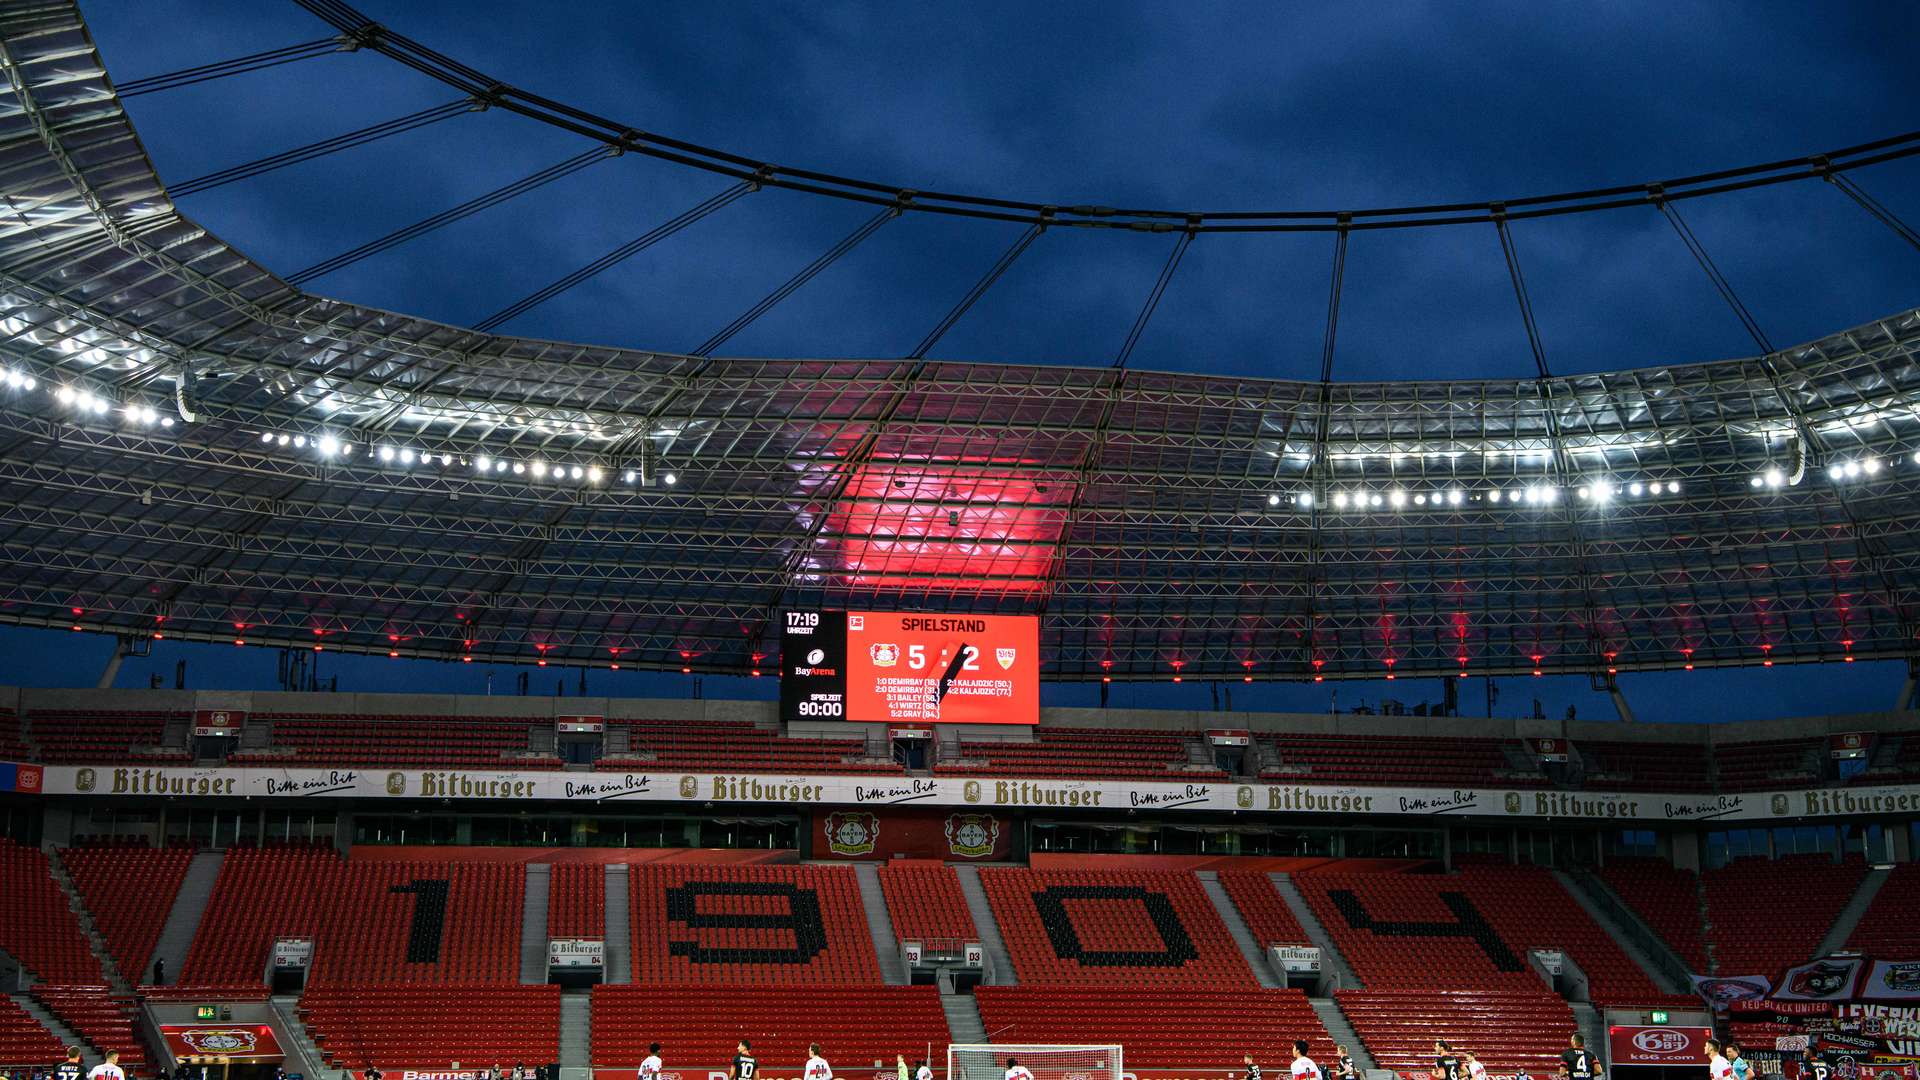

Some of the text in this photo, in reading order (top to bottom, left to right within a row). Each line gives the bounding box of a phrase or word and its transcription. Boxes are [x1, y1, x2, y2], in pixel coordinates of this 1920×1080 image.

[787, 612, 819, 626] 17:19
[902, 618, 986, 633] SPIELSTAND
[908, 645, 926, 669] 5
[962, 646, 980, 671] 2
[795, 667, 835, 676] BayArena
[888, 678, 923, 686] DEMIRBAY
[888, 686, 923, 694] DEMIRBAY
[947, 679, 957, 687] 2:1
[958, 680, 994, 688] KALAJDZIC
[897, 694, 921, 702] BAILEY
[960, 688, 996, 696] KALAJDZIC
[997, 688, 1012, 697] (77.)
[799, 702, 842, 716] 90:00
[899, 702, 922, 710] WIRTZ
[903, 710, 922, 718] GRAY
[112, 769, 236, 794] Bitburger
[267, 771, 356, 795] Bitte ein Bit
[420, 772, 536, 797] Bitburger
[566, 774, 651, 798] Bitte ein Bit
[712, 776, 823, 801] Bitburger
[856, 779, 937, 802] Bitte ein Bit
[995, 781, 1102, 806] Bitburger
[1131, 785, 1210, 807] Bitte ein Bit
[1268, 787, 1373, 811] Bitburger
[1400, 790, 1477, 813] Bitte ein Bit
[1535, 792, 1638, 818] Bitburger
[1805, 790, 1920, 815] Bitburger
[1664, 796, 1743, 819] Bitte ein Bit
[561, 944, 601, 953] Bitburger
[1282, 950, 1319, 959] Bitburger
[970, 953, 980, 961] D3
[1742, 1000, 1828, 1014] RED-BLACK UNITED
[740, 1062, 753, 1079] 10
[1576, 1055, 1587, 1072] 4
[1449, 1066, 1458, 1080] 6
